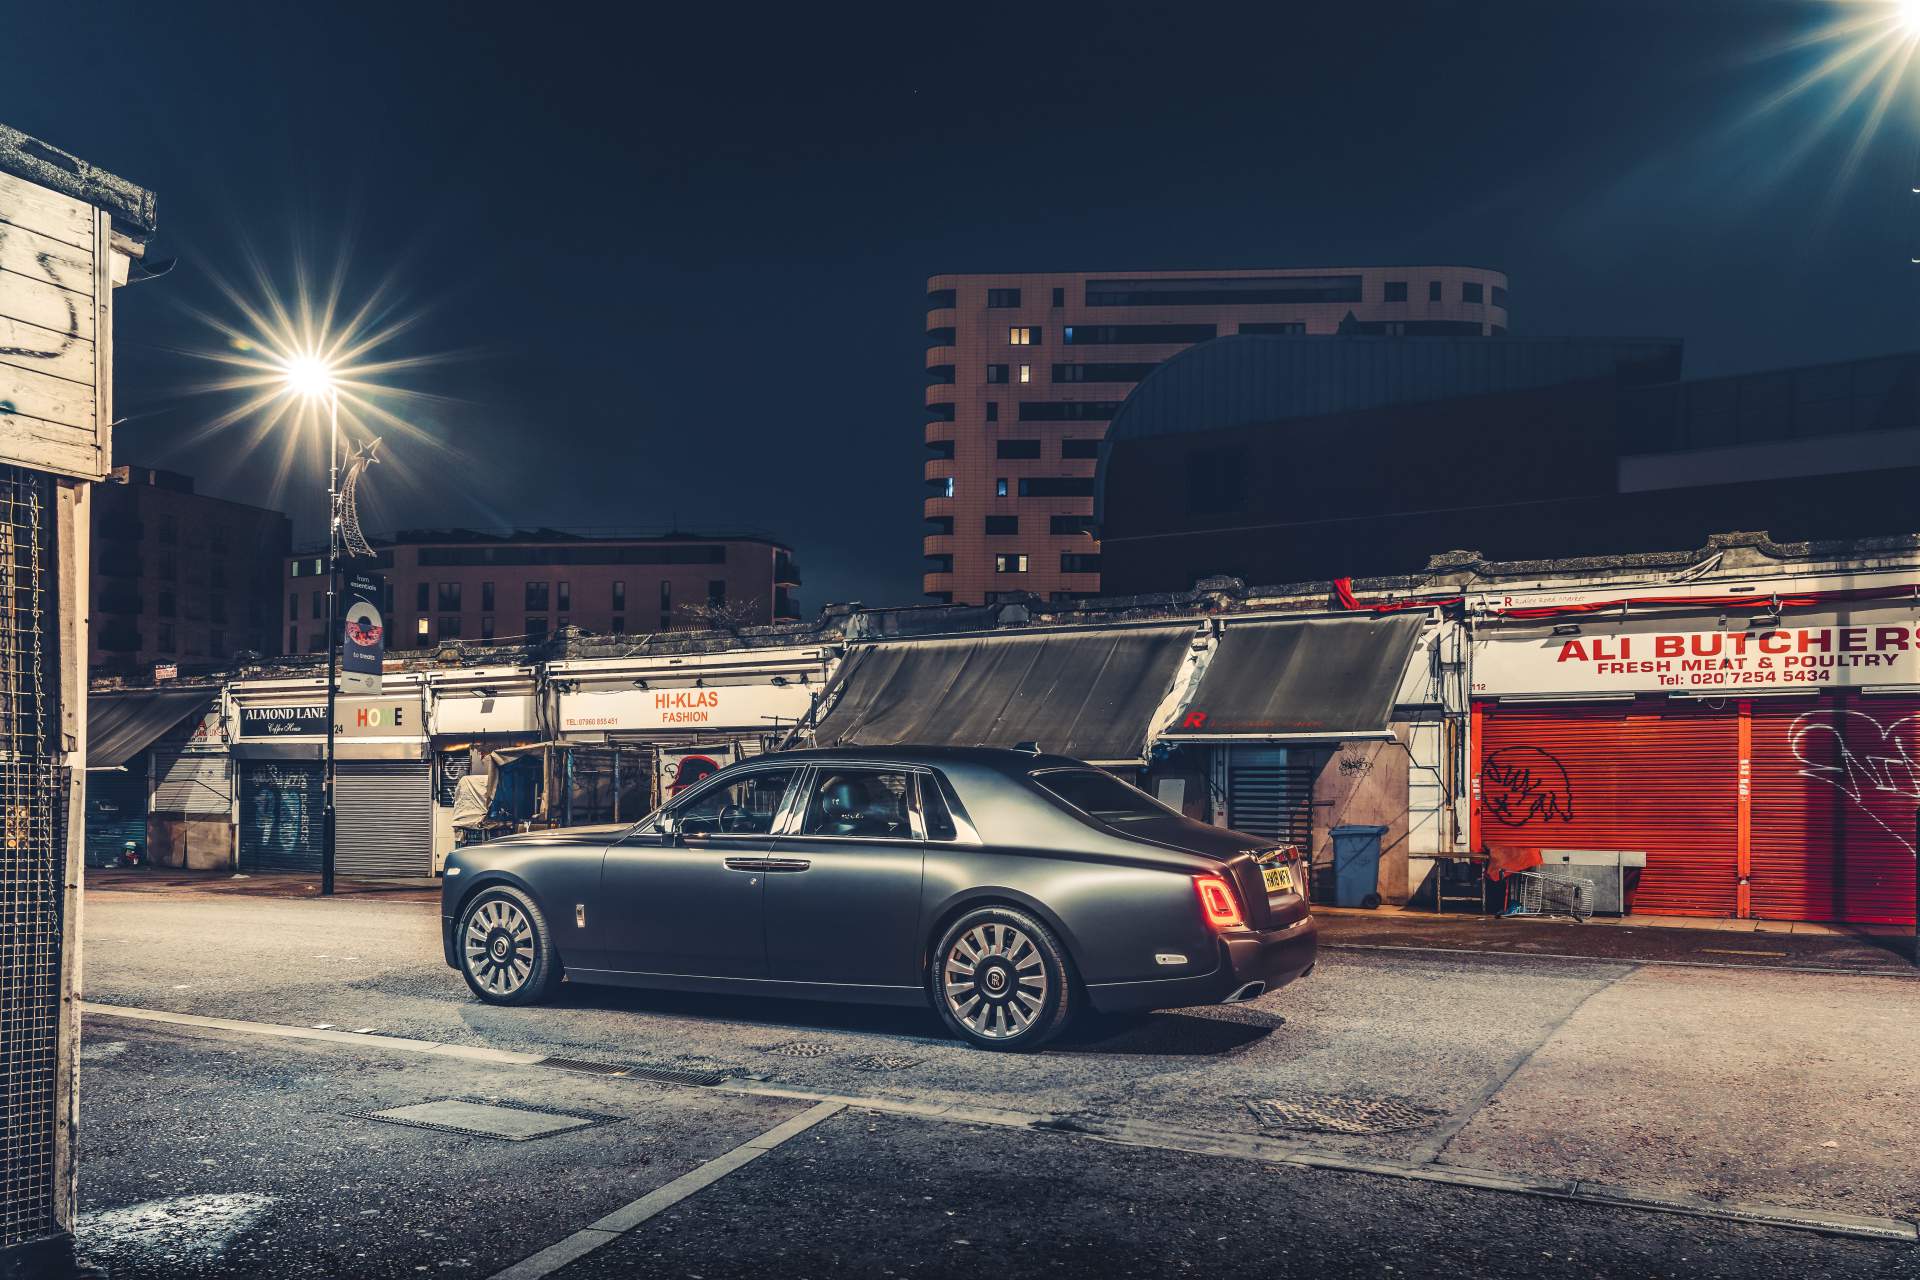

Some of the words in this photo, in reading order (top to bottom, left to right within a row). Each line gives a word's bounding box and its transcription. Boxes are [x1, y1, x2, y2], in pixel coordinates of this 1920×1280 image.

[350, 581, 377, 591] essentials
[1504, 596, 1513, 607] R
[1557, 637, 1631, 662] ALI
[1597, 658, 1670, 675] FRESH
[1681, 658, 1748, 672] MEAT
[1758, 656, 1773, 670] &
[1784, 653, 1899, 669] POULTRY
[1657, 673, 1684, 686] Tel:
[1690, 672, 1725, 685] 020
[1732, 670, 1777, 684] 7254
[1783, 669, 1830, 682] 5434
[1472, 683, 1487, 691] 112
[655, 691, 719, 708] HI-KLAS
[245, 708, 295, 720] ALMOND
[296, 707, 327, 719] LANE
[357, 706, 403, 727] HOME
[662, 711, 708, 723] FASHION
[1183, 711, 1208, 728] R
[334, 724, 344, 734] 24
